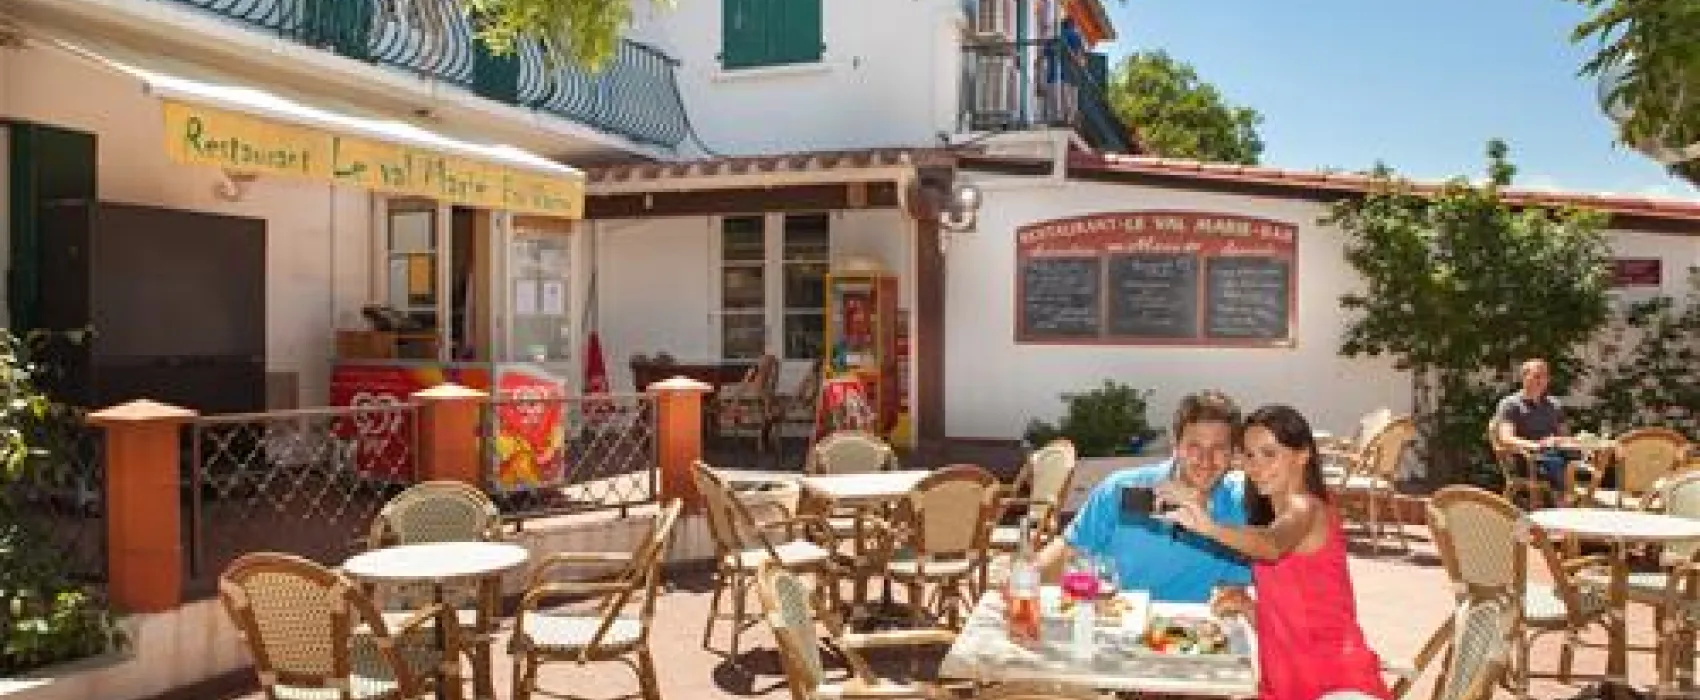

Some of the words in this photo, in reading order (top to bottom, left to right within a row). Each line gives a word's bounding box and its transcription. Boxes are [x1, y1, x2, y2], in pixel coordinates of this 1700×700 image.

[186, 115, 310, 175] Restaurant
[332, 136, 368, 177] Le
[1019, 218, 1116, 244] RESTAURANT
[1154, 216, 1184, 232] VAL
[1194, 218, 1251, 237] MARIE
